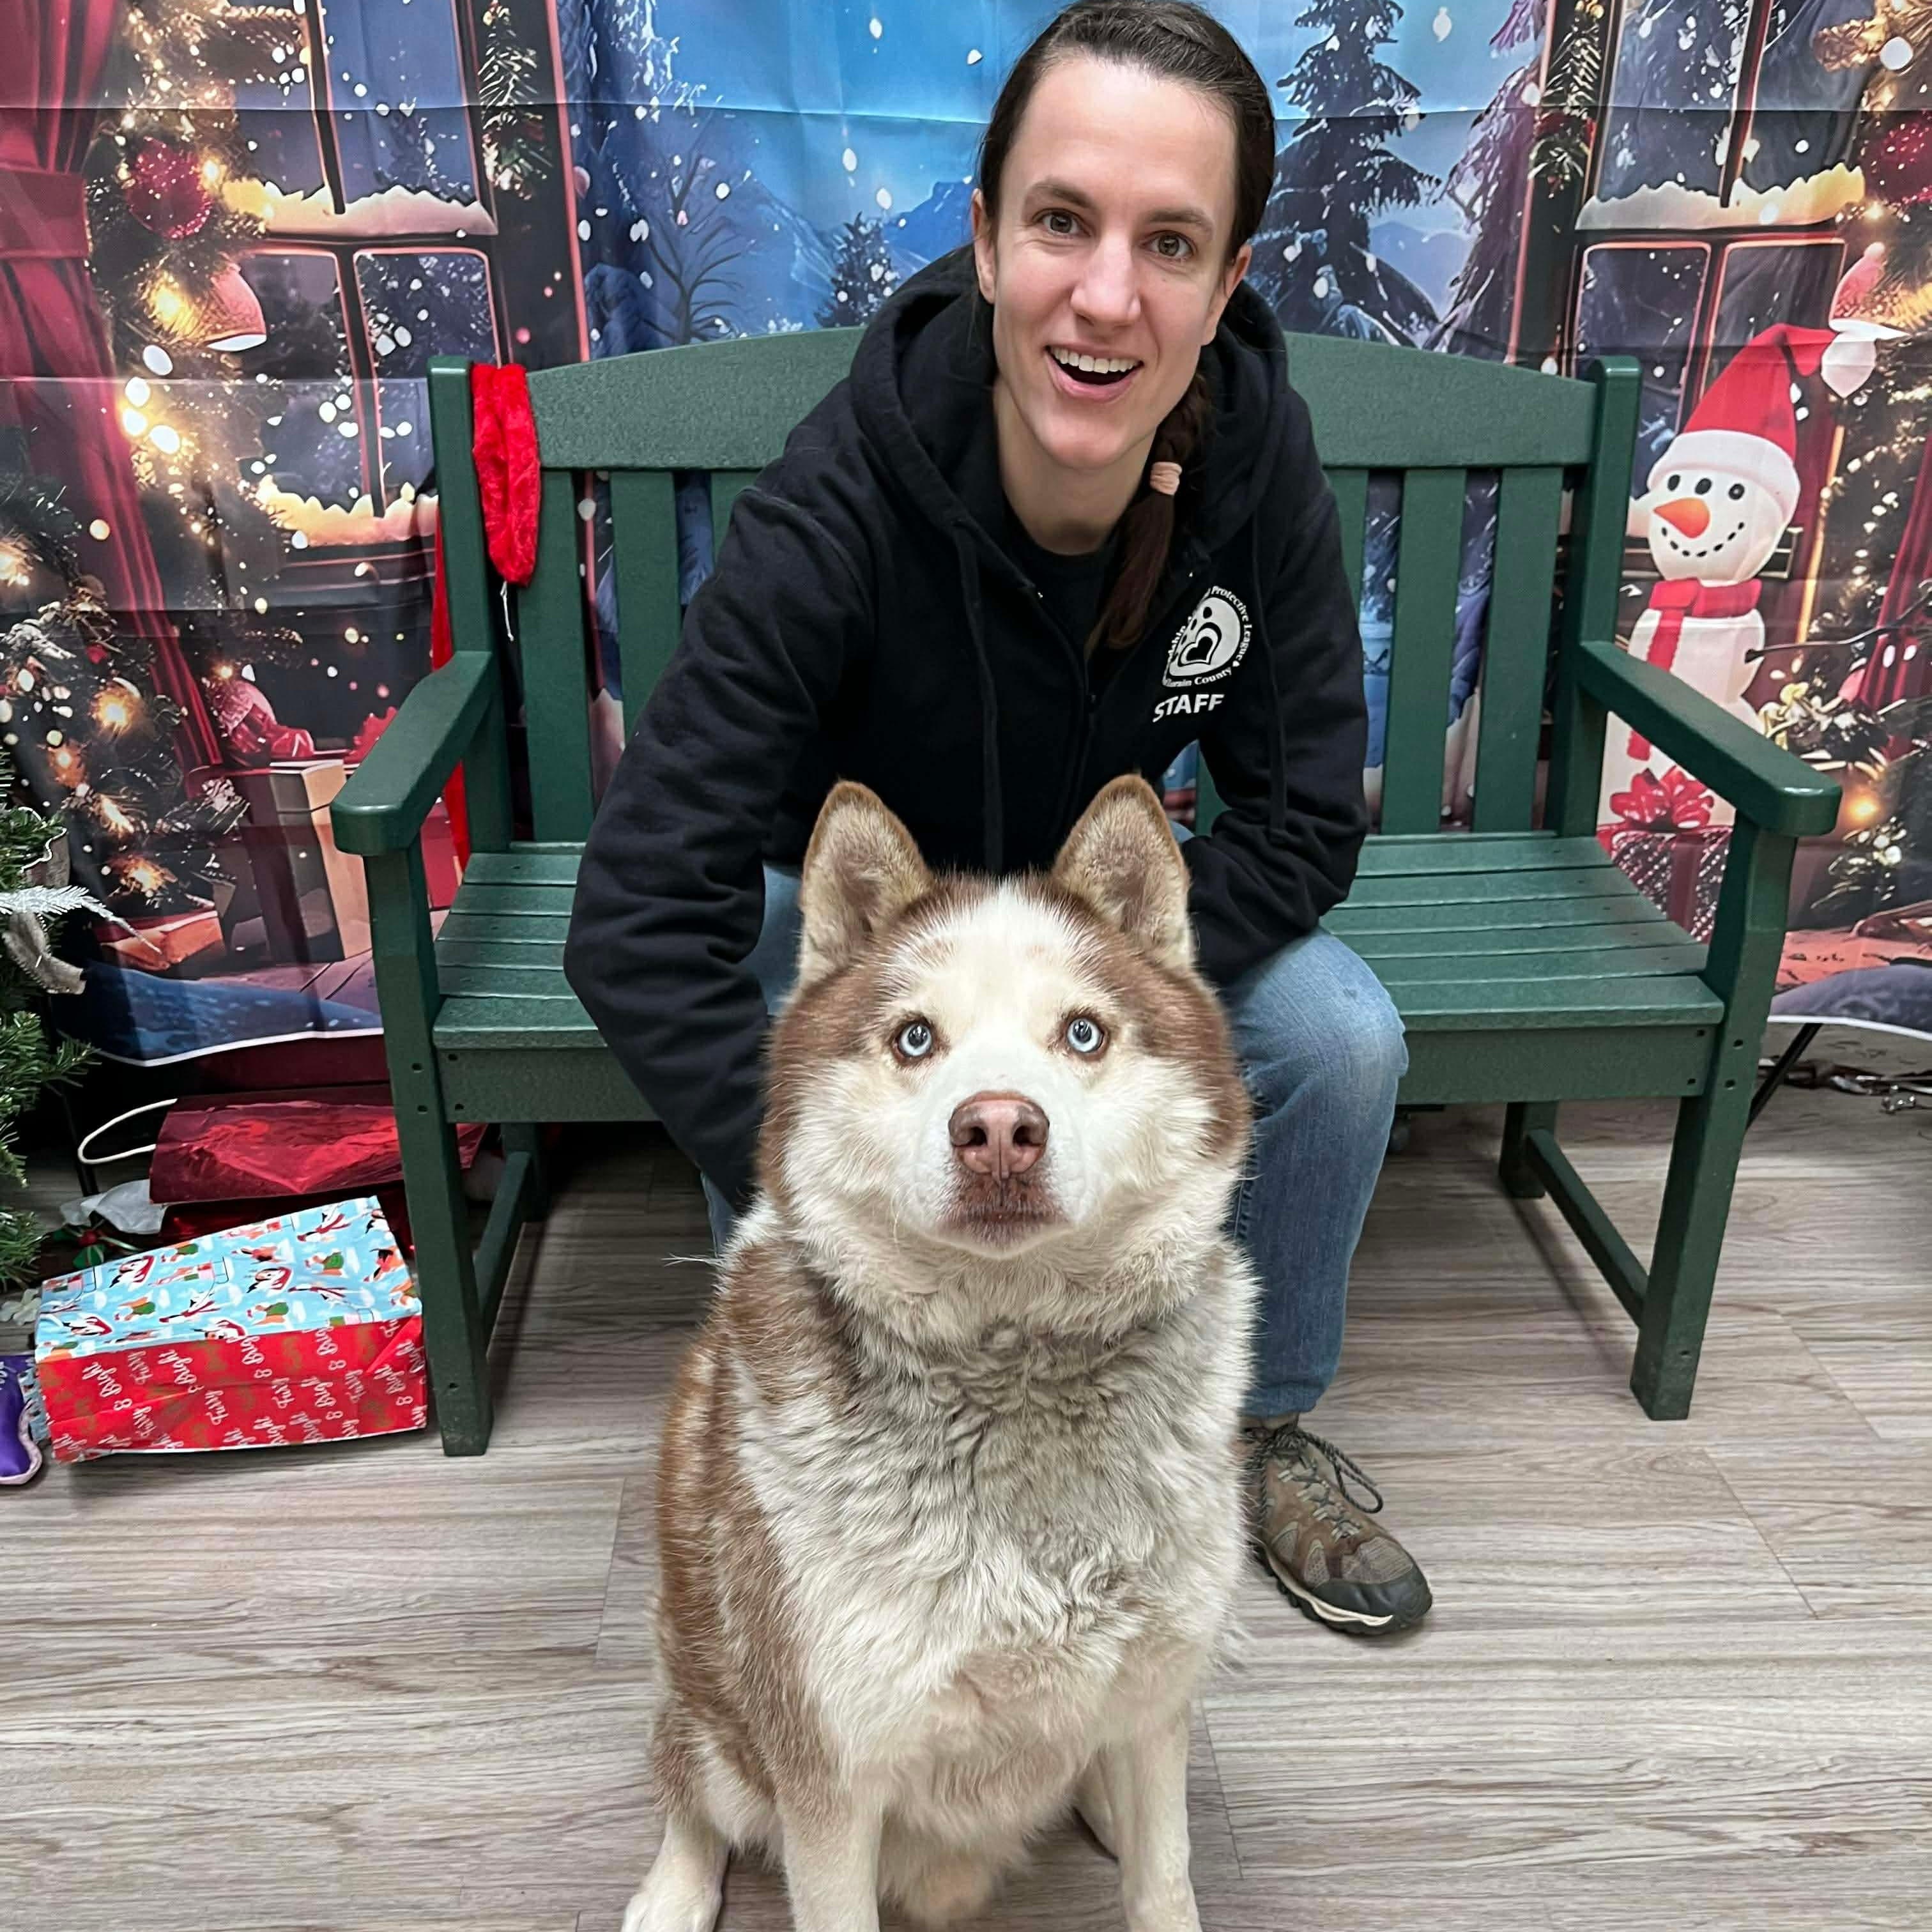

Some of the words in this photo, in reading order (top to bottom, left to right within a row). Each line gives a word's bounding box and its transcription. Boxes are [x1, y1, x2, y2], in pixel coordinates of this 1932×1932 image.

[1211, 585, 1249, 622] Protective
[1235, 624, 1252, 661] League
[1194, 666, 1232, 685] County
[1153, 694, 1224, 723] STAFF
